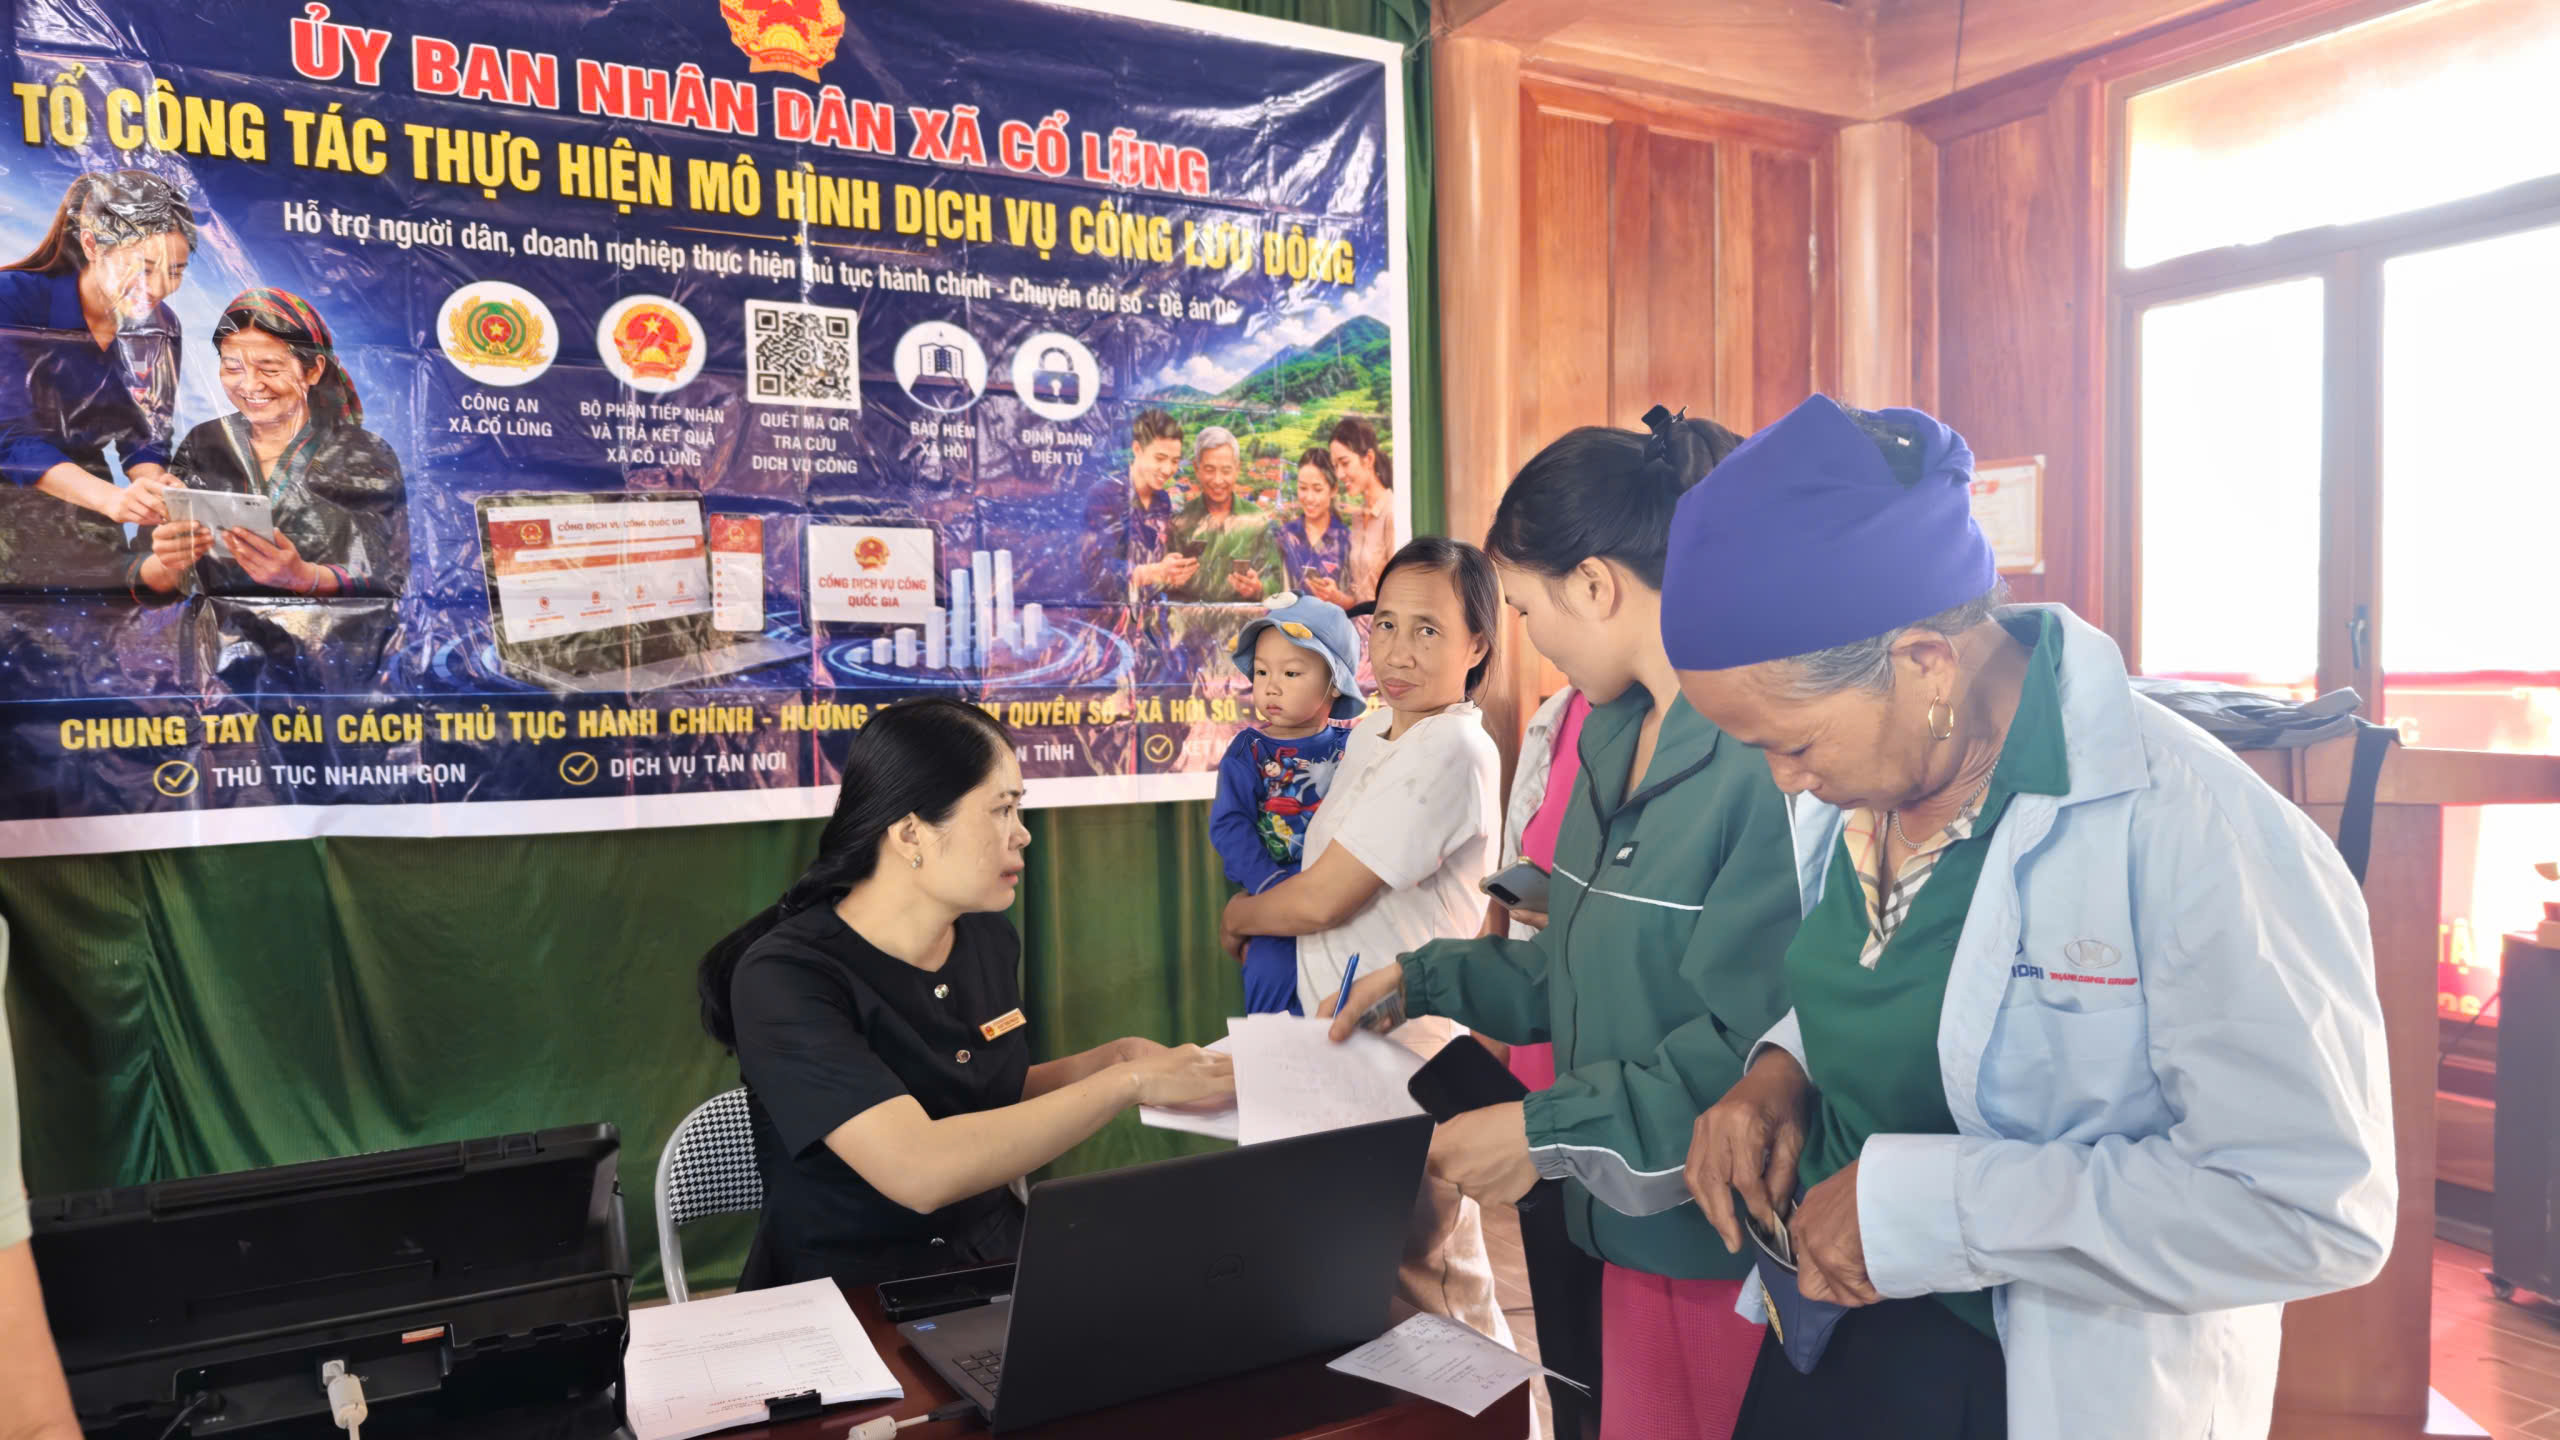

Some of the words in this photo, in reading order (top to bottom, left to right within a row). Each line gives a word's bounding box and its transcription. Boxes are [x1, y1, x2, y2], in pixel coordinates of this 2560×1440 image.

[290, 2, 391, 86] ỦY
[412, 36, 560, 110] BAN
[577, 57, 757, 136] NHÂN
[774, 84, 897, 156] DÂN
[909, 106, 986, 169] XÃ
[1000, 110, 1071, 178] CỔ
[1082, 126, 1210, 197] LŨNG
[12, 63, 88, 147] TỔ
[107, 78, 268, 161] CÔNG
[284, 104, 388, 176] TÁC
[405, 124, 541, 198] THỰC
[559, 138, 673, 213] HIỆN
[688, 154, 760, 218] MÔ
[776, 163, 881, 231] HÌNH
[895, 184, 992, 247] DỊCH
[1005, 198, 1057, 261] VỤ
[1070, 200, 1173, 263] CÔNG
[1184, 220, 1253, 272] LƯU
[1264, 225, 1355, 288] ĐỘNG
[284, 200, 321, 234] Hỗ
[332, 208, 370, 245] trợ
[379, 217, 452, 249] người
[461, 220, 516, 257] dân,
[523, 228, 599, 261] doanh
[607, 239, 685, 275] nghiệp
[693, 244, 743, 279] thực
[749, 248, 796, 284] hiện
[839, 261, 873, 292] tục
[880, 263, 930, 294] hành
[936, 270, 991, 299] chính
[1010, 277, 1081, 312] Chuyển
[1086, 282, 1115, 313] đổi
[1120, 290, 1142, 314] số
[1159, 291, 1183, 318] Đề
[1189, 296, 1211, 321] án
[461, 393, 510, 411] CÔNG
[515, 398, 539, 413] AN
[580, 399, 601, 420] BỘ
[606, 401, 646, 419] PHẬN
[650, 402, 681, 420] TIẾP
[448, 416, 472, 433] XÃ
[478, 414, 501, 434] CỔ
[507, 418, 553, 437] LŨNG
[760, 411, 798, 428] QUÉT
[803, 413, 825, 430] MÃ
[828, 416, 850, 431] QR
[590, 422, 612, 440] VÀ
[616, 423, 647, 441] TRẢ
[652, 424, 680, 443] KẾT
[772, 434, 802, 450] TRA
[1056, 430, 1093, 447] DANH
[752, 455, 788, 473] DỊCH
[815, 456, 858, 474] CÔNG
[881, 595, 900, 607] GIA
[1008, 694, 1082, 729] QUYỀN
[1136, 695, 1164, 723] XÃ
[60, 714, 187, 750] CHUNG
[202, 713, 259, 744] TAY
[272, 705, 322, 743] CẢI
[338, 708, 423, 743] CÁCH
[436, 703, 496, 742] THỦ
[508, 711, 566, 745] TỤC
[579, 704, 658, 739] HÀNH
[670, 700, 753, 735] CHÍNH
[780, 699, 868, 731] HƯỚNG
[1033, 740, 1075, 762] TÌNH
[212, 759, 261, 787] THỦ
[271, 764, 316, 789] TỤC
[325, 764, 408, 785] NHANH
[417, 763, 466, 787] GỌN
[610, 755, 660, 778] DỊCH
[669, 755, 696, 776] VỤ
[704, 751, 748, 776] TẬN
[753, 751, 786, 772] NƠI
